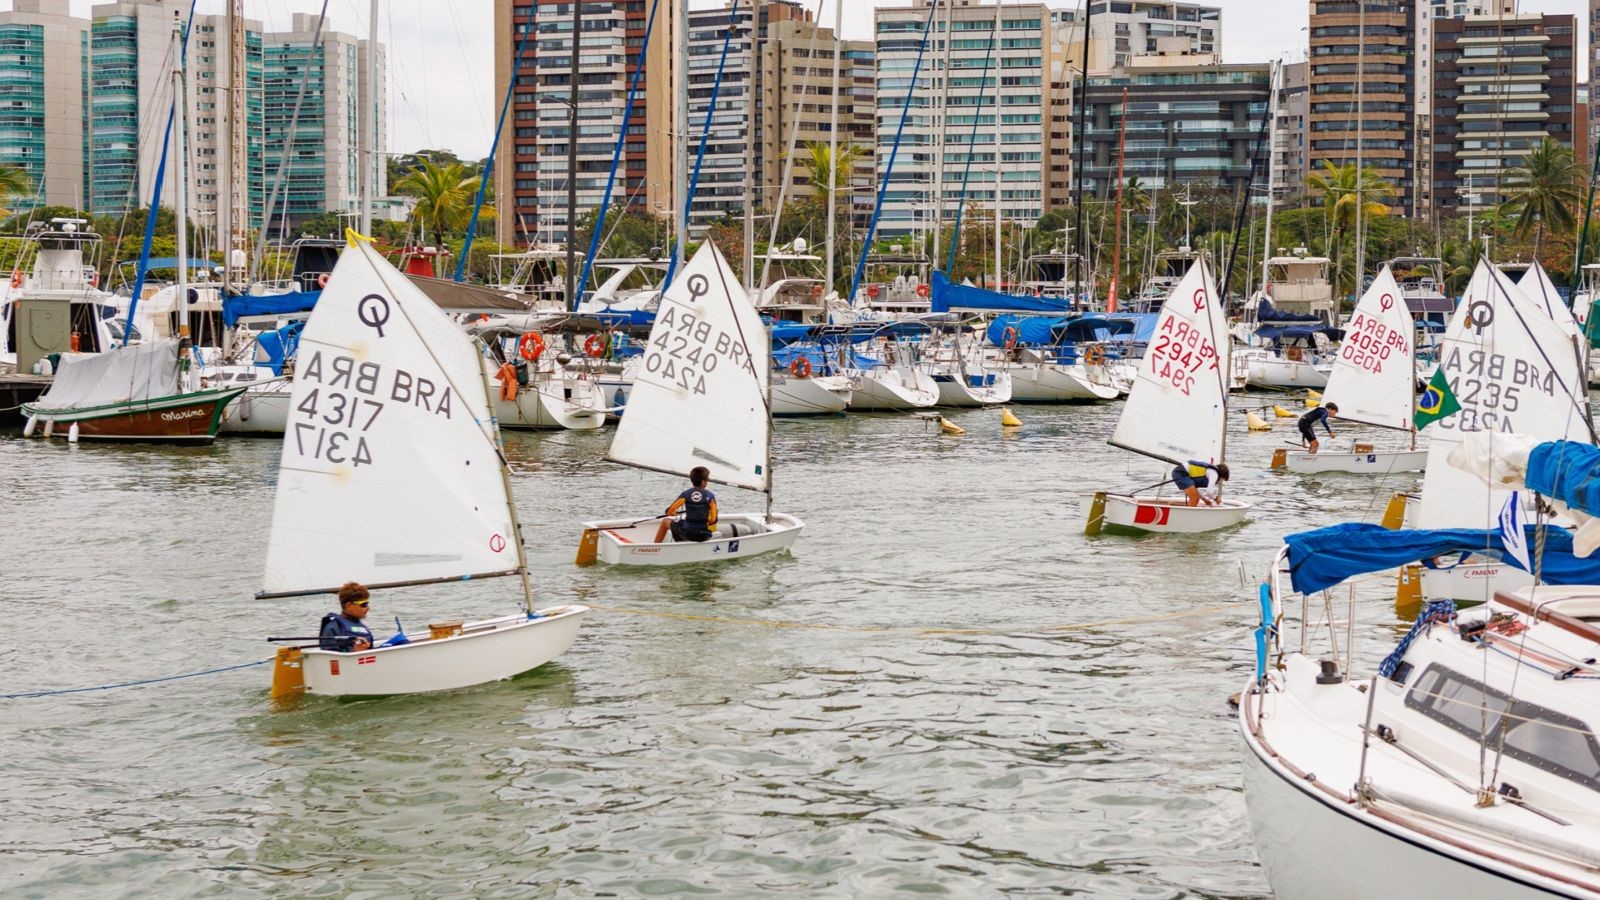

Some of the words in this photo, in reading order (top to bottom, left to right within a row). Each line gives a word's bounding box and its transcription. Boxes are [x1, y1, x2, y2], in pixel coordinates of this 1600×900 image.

[653, 331, 717, 373] 4240
[714, 331, 752, 375] BRA
[1154, 335, 1204, 373] 2947
[1349, 331, 1391, 360] 4050
[1386, 329, 1408, 357] BRA
[390, 369, 451, 420] BRA
[1513, 358, 1554, 397] BRA
[160, 409, 206, 421] Marina
[297, 388, 384, 431] 4317
